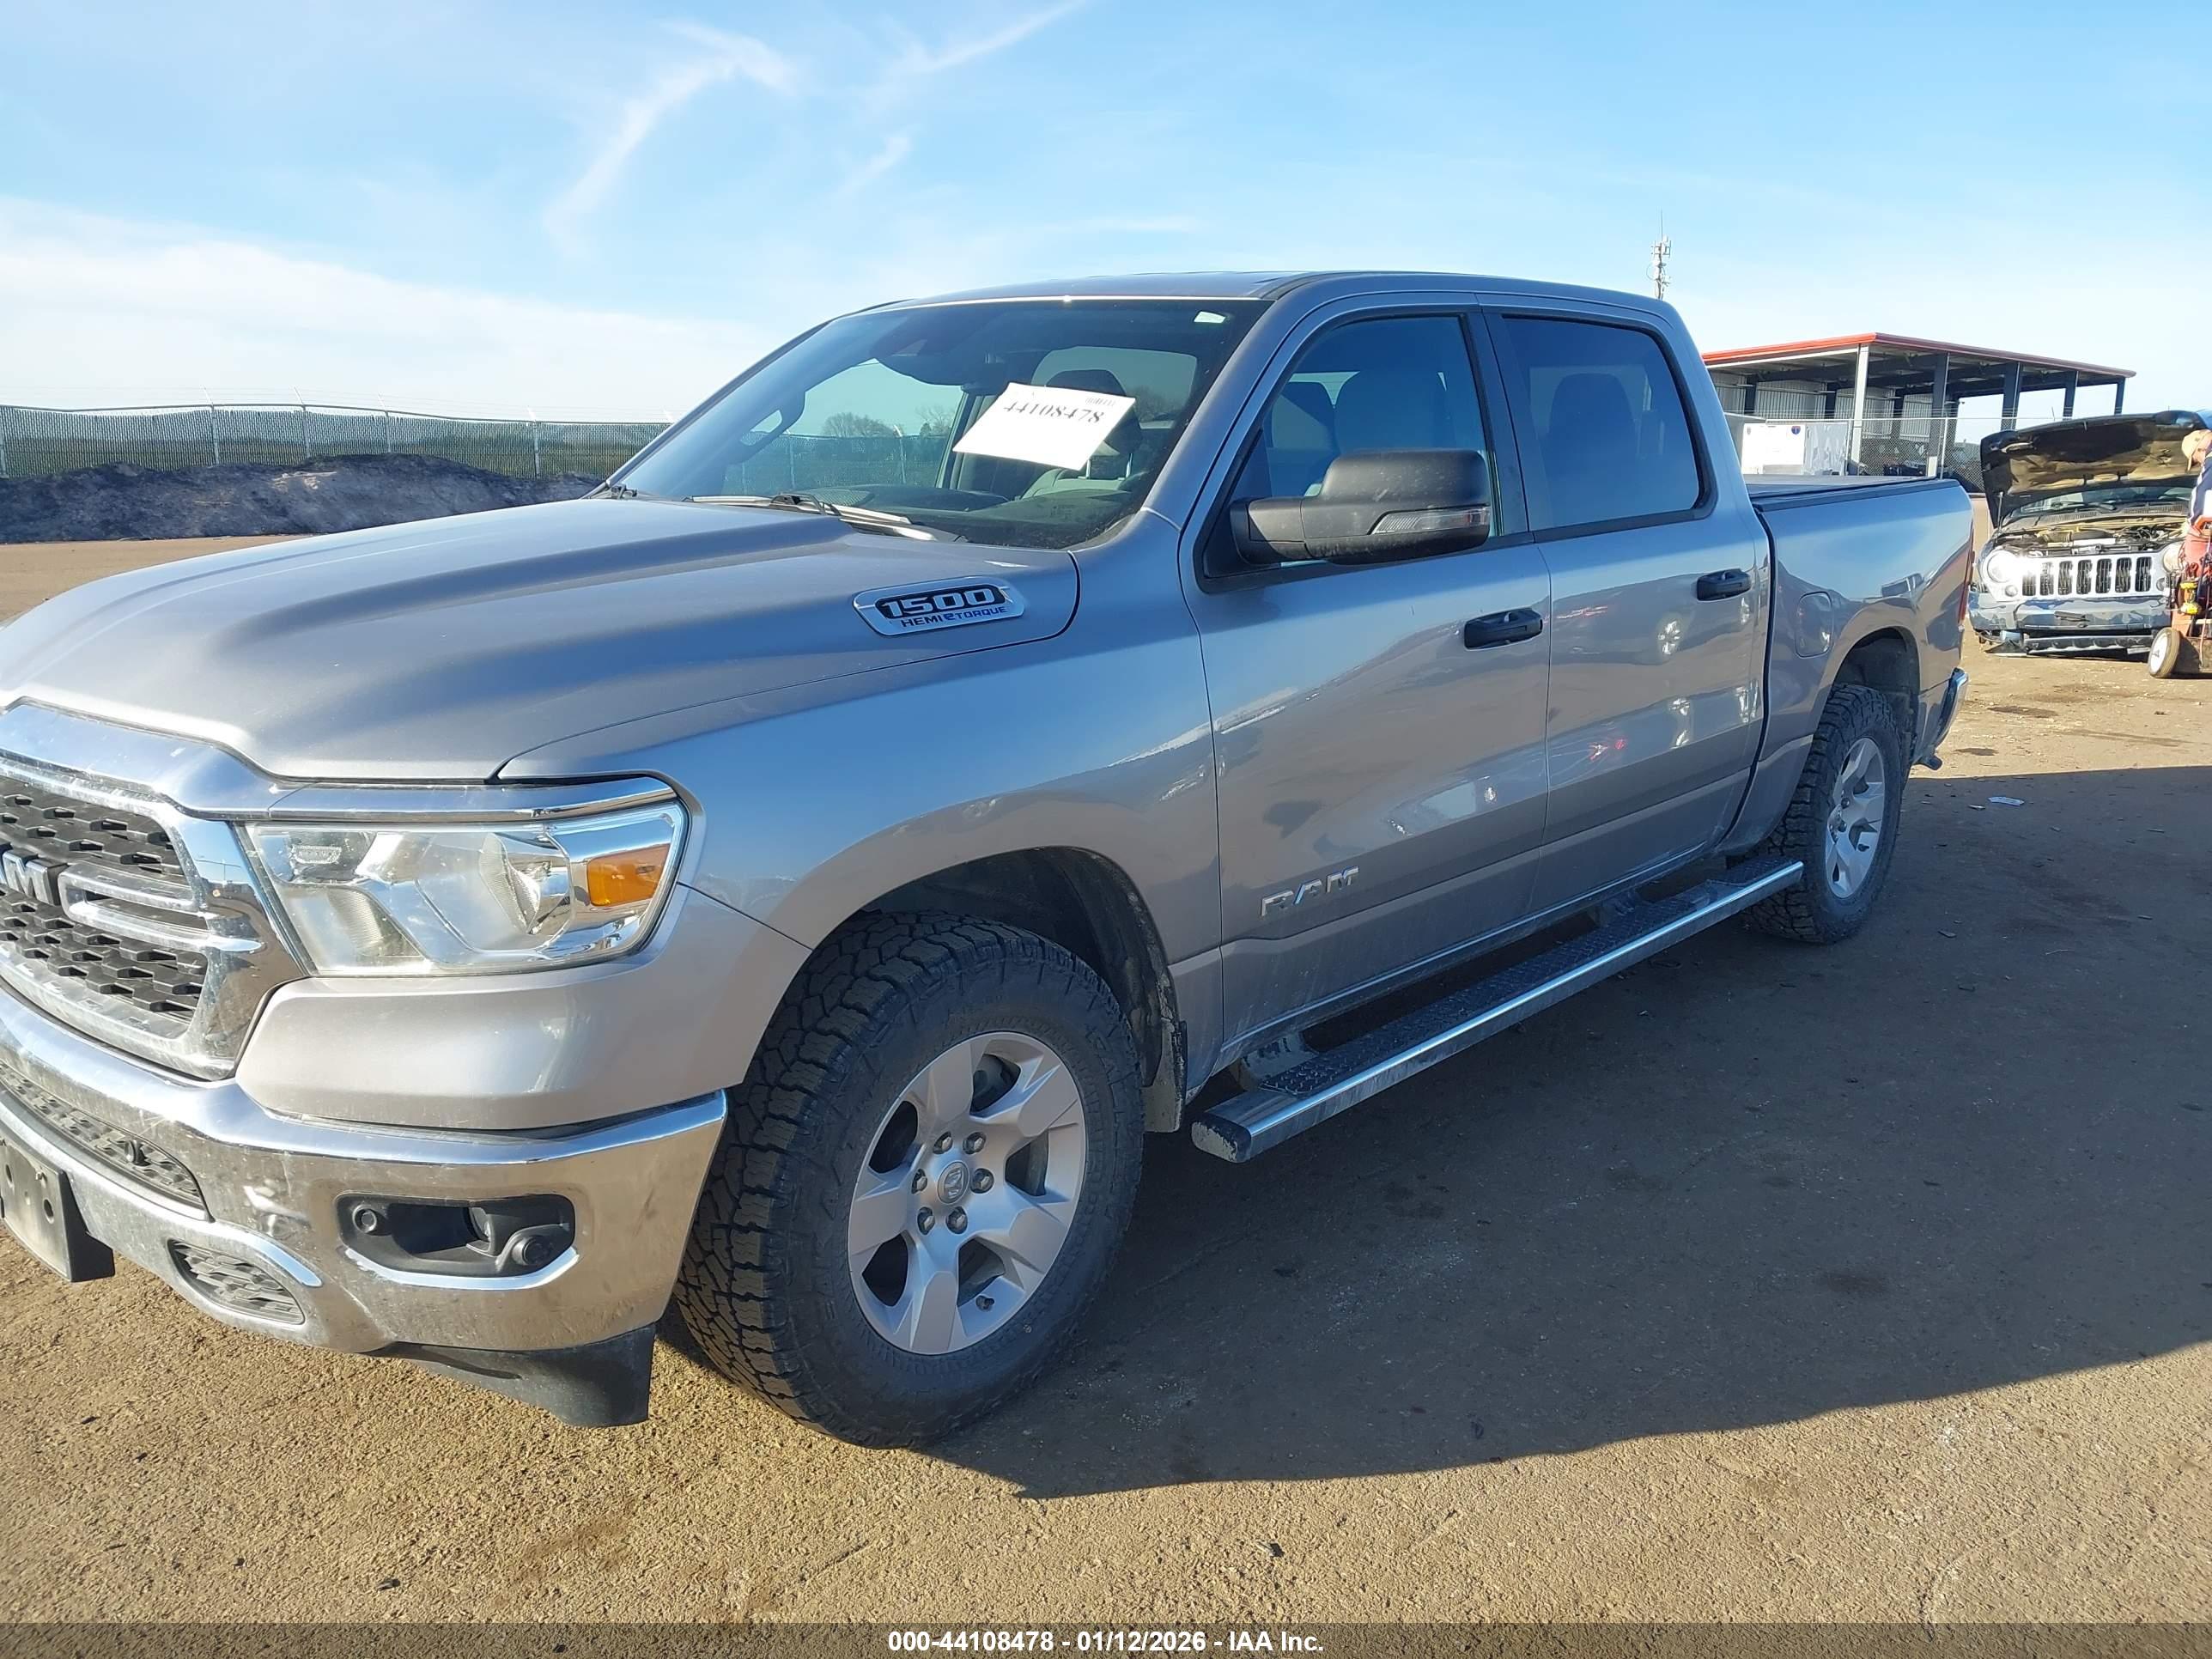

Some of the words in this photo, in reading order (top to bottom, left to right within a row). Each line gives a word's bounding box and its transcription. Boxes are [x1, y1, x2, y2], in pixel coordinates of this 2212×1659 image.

[1003, 400, 1104, 423] 44108478
[881, 587, 995, 617] 1500
[902, 614, 943, 628] HEMI
[1261, 865, 1359, 917] RAM
